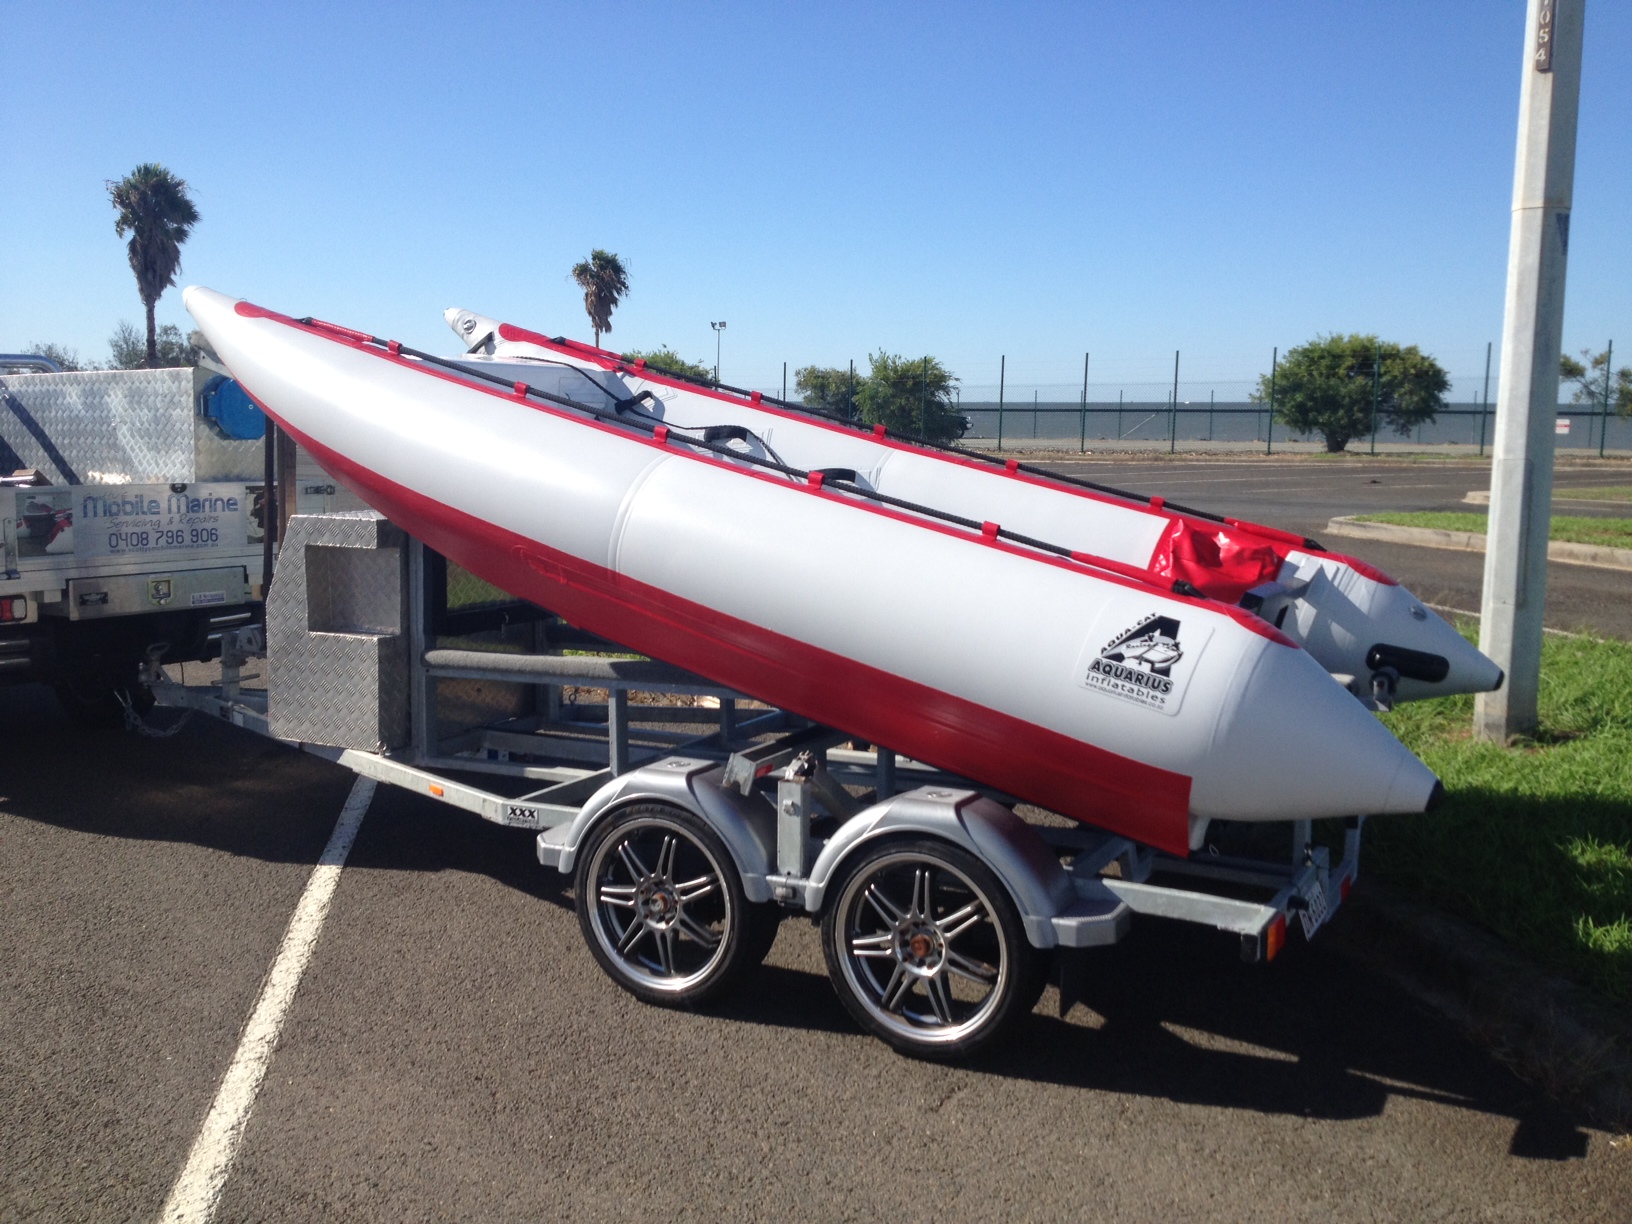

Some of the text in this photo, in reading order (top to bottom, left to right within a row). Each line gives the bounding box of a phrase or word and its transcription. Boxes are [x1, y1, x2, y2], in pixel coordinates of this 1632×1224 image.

[82, 492, 239, 518] Mobile Marine
[106, 513, 219, 531] Servicing & Repairs
[108, 527, 219, 549] 0408 796 906
[1101, 612, 1156, 654] AQUA-CAT
[1089, 659, 1173, 695] AQUARIUS
[509, 807, 536, 818] XXX
